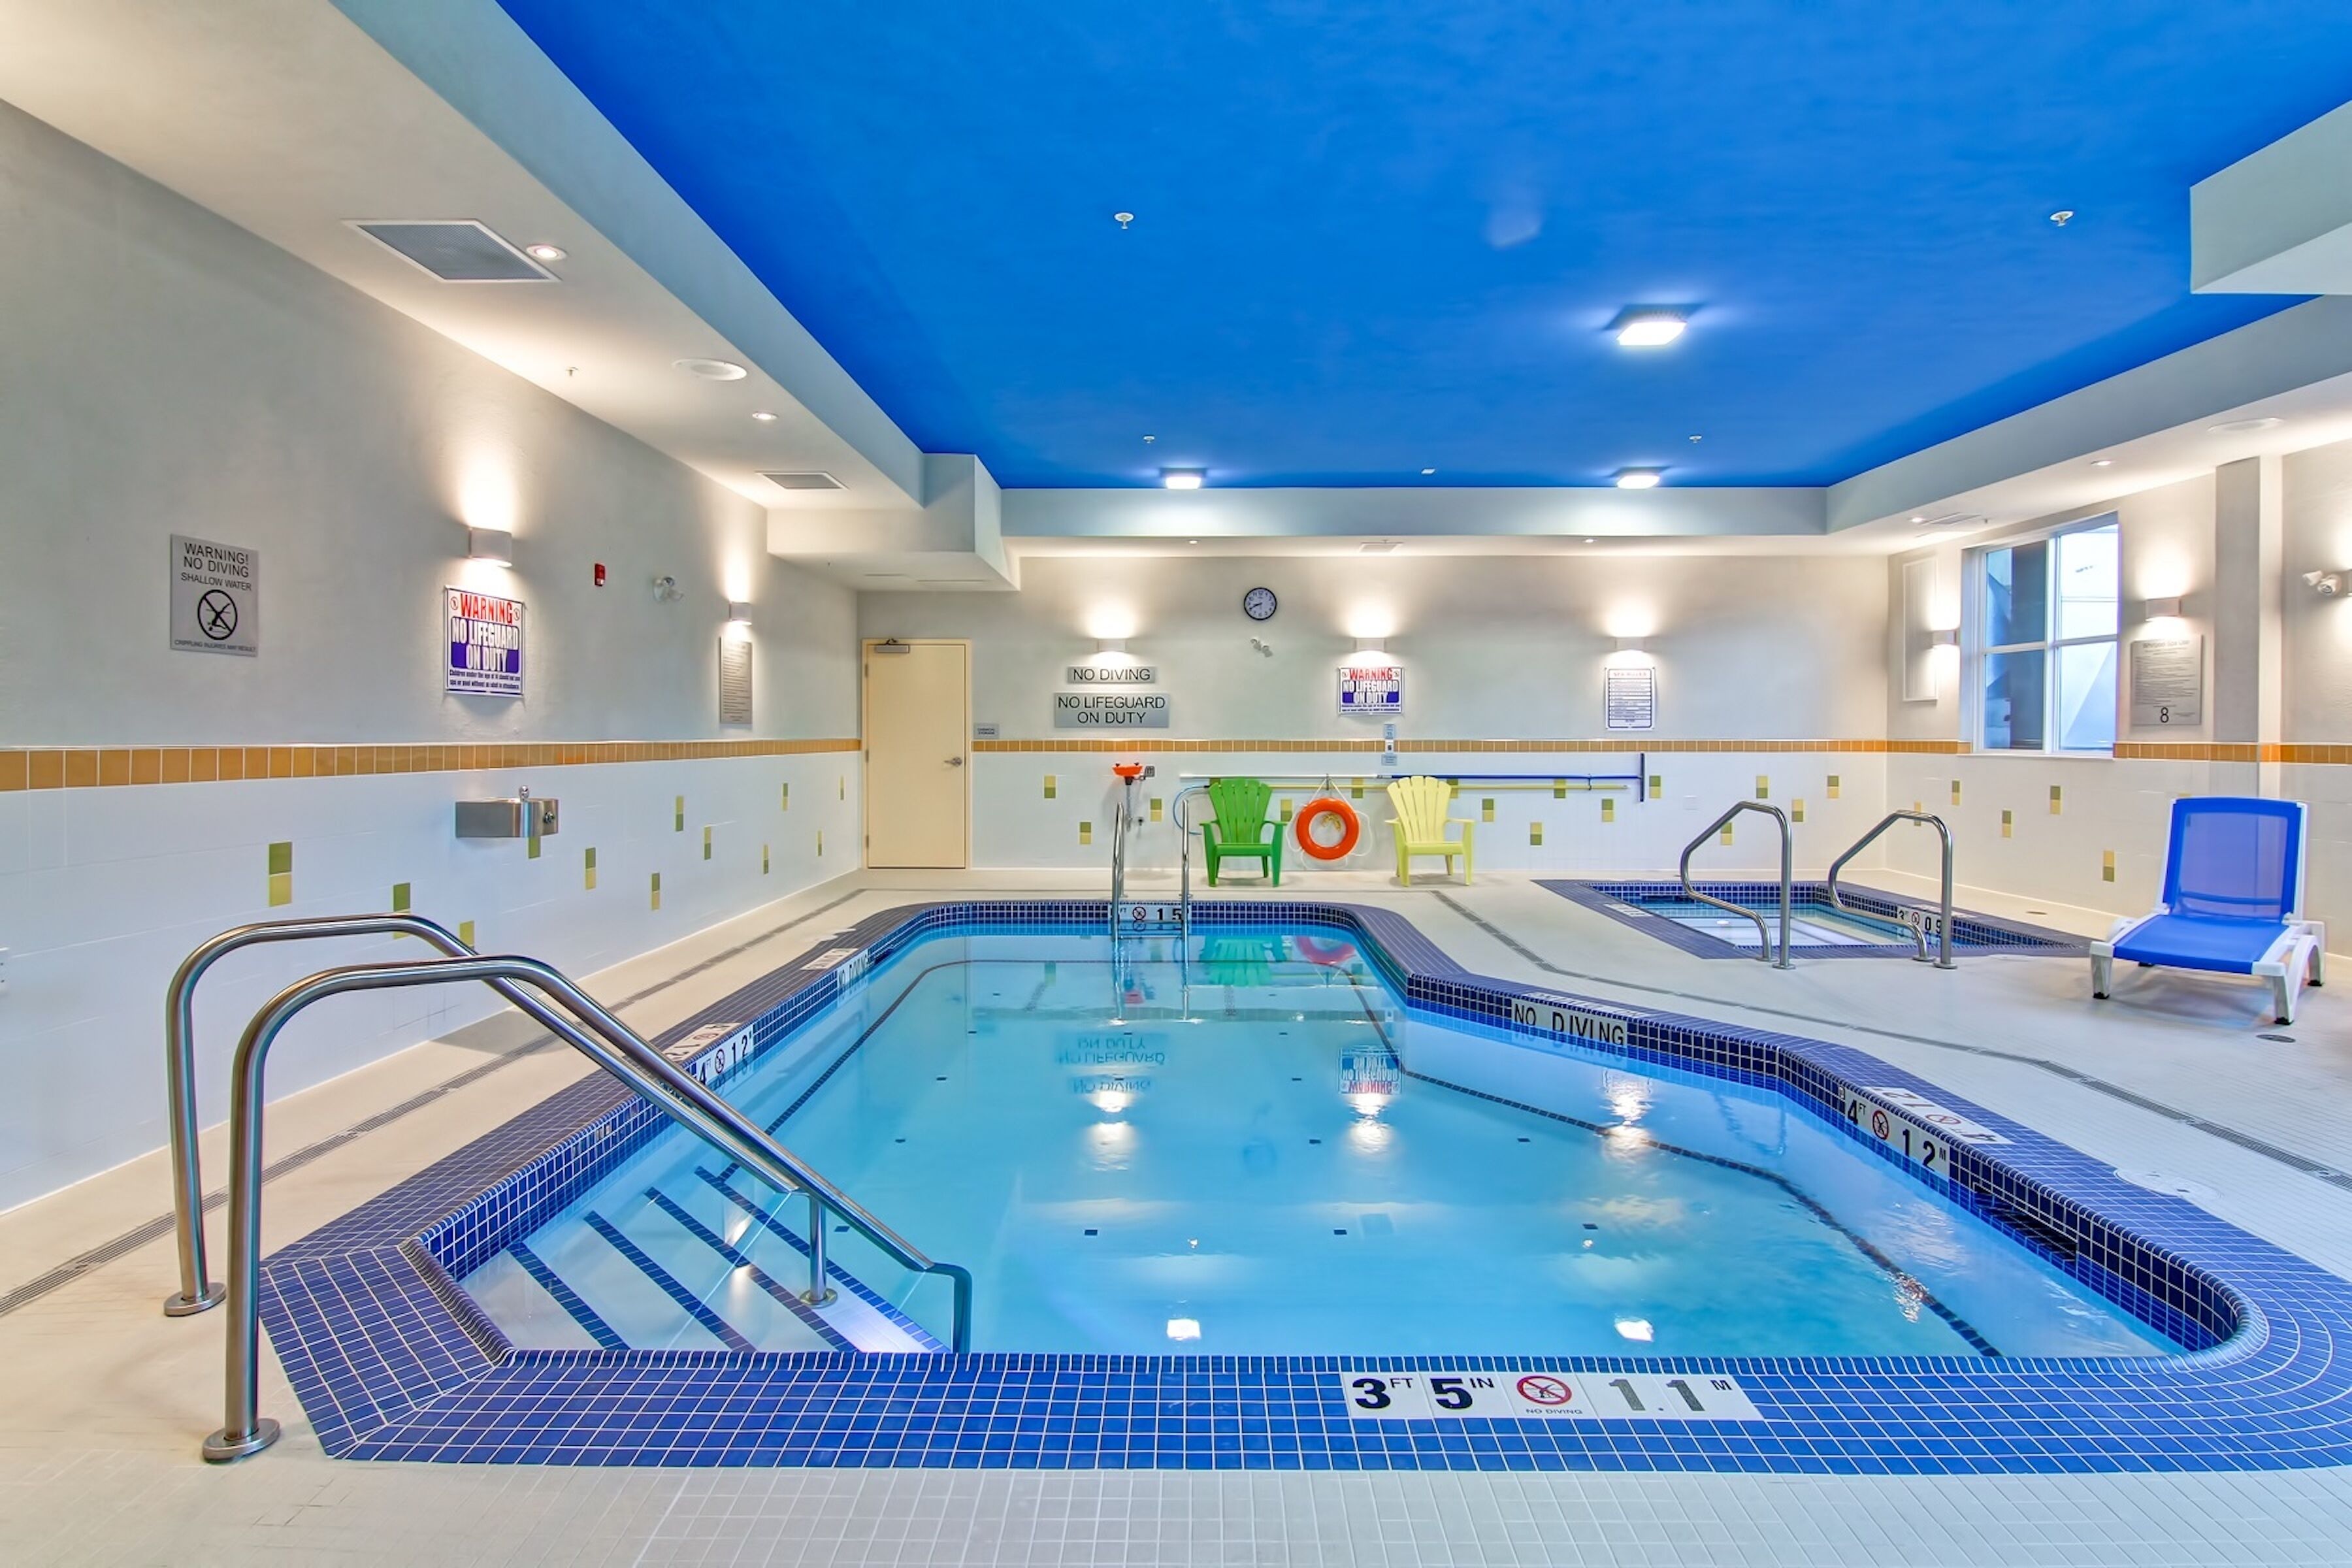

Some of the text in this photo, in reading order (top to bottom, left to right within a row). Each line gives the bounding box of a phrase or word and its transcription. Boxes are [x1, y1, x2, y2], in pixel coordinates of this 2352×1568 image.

[185, 542, 249, 565] WARNING!
[184, 557, 249, 578] NO DIVING
[181, 572, 252, 591] SHALLOW WATER
[460, 593, 513, 624] WARNING
[452, 617, 519, 650] NO LIFEGUARD
[466, 644, 508, 673] ON DUTY
[1073, 668, 1151, 681] NO DIVING
[1349, 668, 1393, 681] WARNING
[1343, 680, 1399, 692] NO LIFEGUARD
[1058, 696, 1166, 709] NO LIFEGUARD
[1353, 692, 1388, 704] ON DUTY
[1077, 711, 1146, 724] ON DUTY
[2160, 706, 2169, 723] 8
[1514, 1003, 1537, 1026] NO
[1552, 1011, 1624, 1046] DIVING
[700, 1062, 706, 1085] 4
[1848, 1099, 1858, 1125] 4
[1859, 1103, 1866, 1116] FT
[1939, 1147, 1946, 1162] M
[1352, 1378, 1391, 1409] 3
[1390, 1378, 1413, 1388] FT
[1430, 1378, 1473, 1409] 5
[1470, 1378, 1495, 1388] IN
[1710, 1379, 1733, 1391] M
